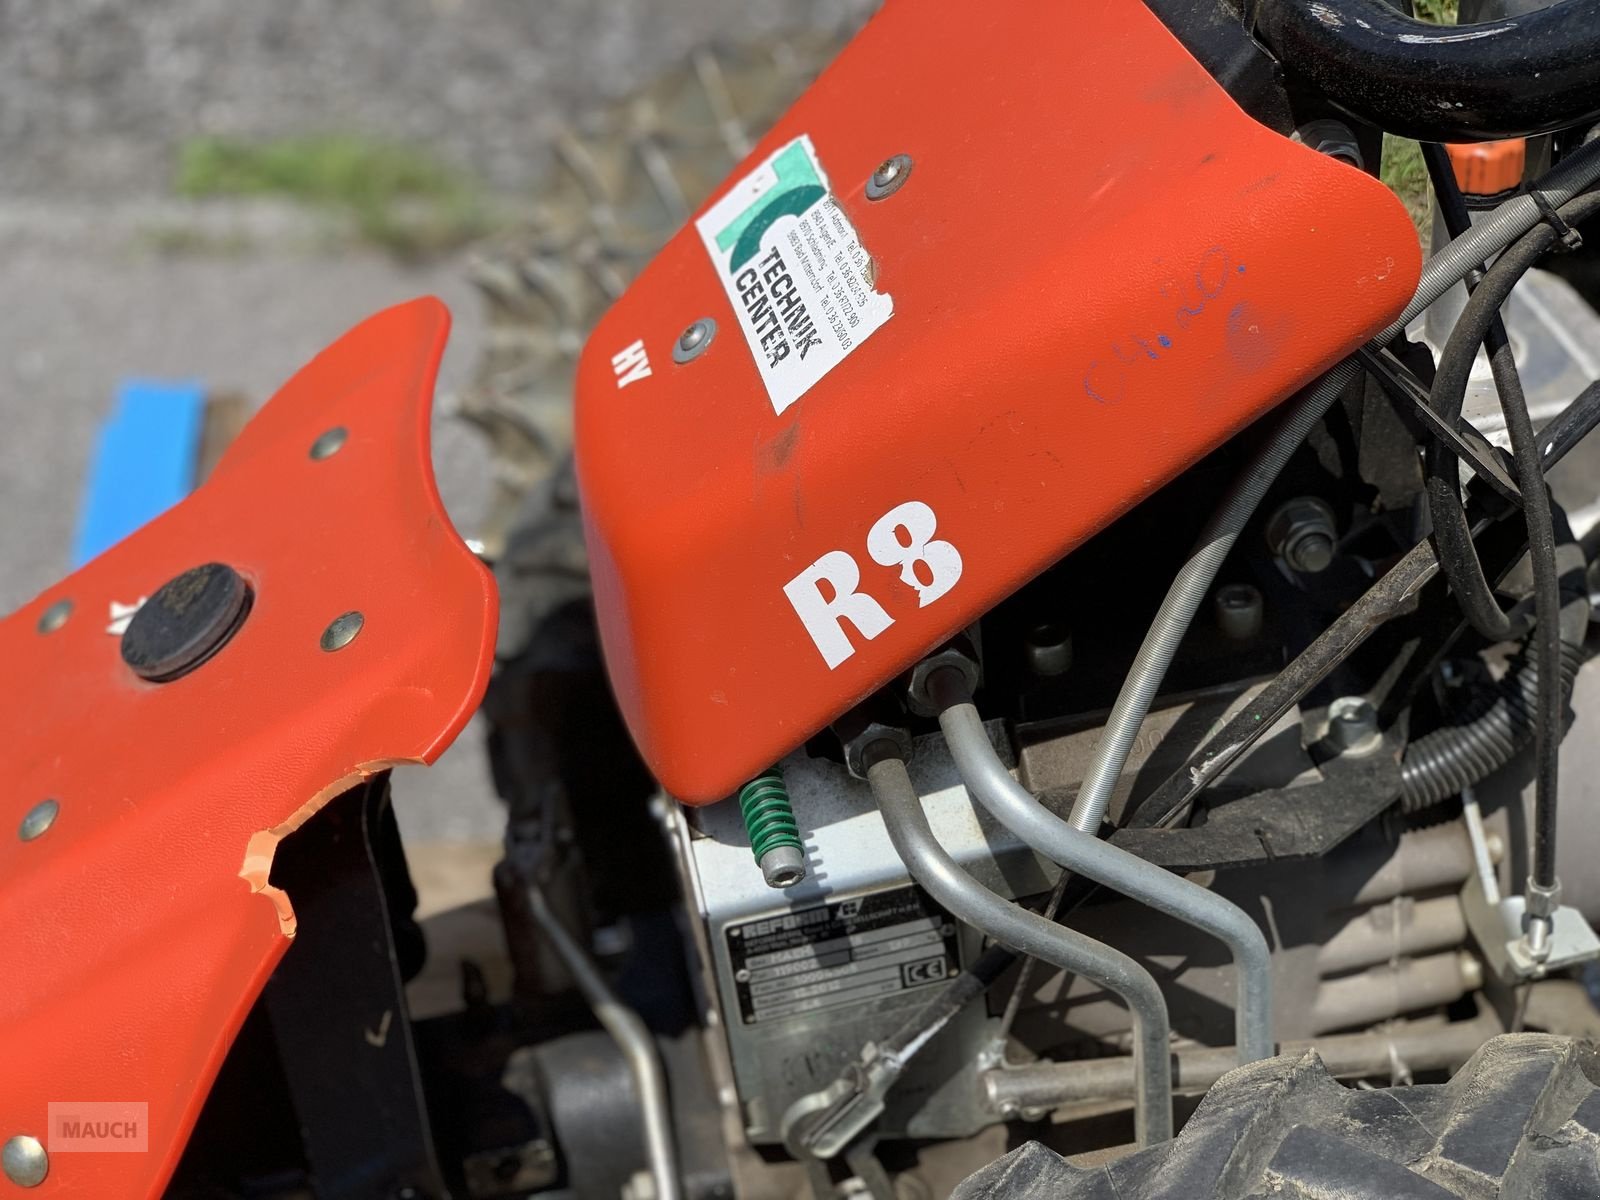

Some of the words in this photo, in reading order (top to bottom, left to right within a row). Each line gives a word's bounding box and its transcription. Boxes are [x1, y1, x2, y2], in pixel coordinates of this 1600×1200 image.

[804, 232, 829, 271] Schladming
[825, 270, 837, 286] Tel.
[833, 250, 845, 265] Tel.
[845, 239, 857, 255] Tel.
[760, 247, 822, 360] TECHNIK
[793, 243, 806, 259] Bad
[819, 294, 832, 310] Tel.
[735, 268, 791, 368] CENTER
[611, 339, 653, 390] HY
